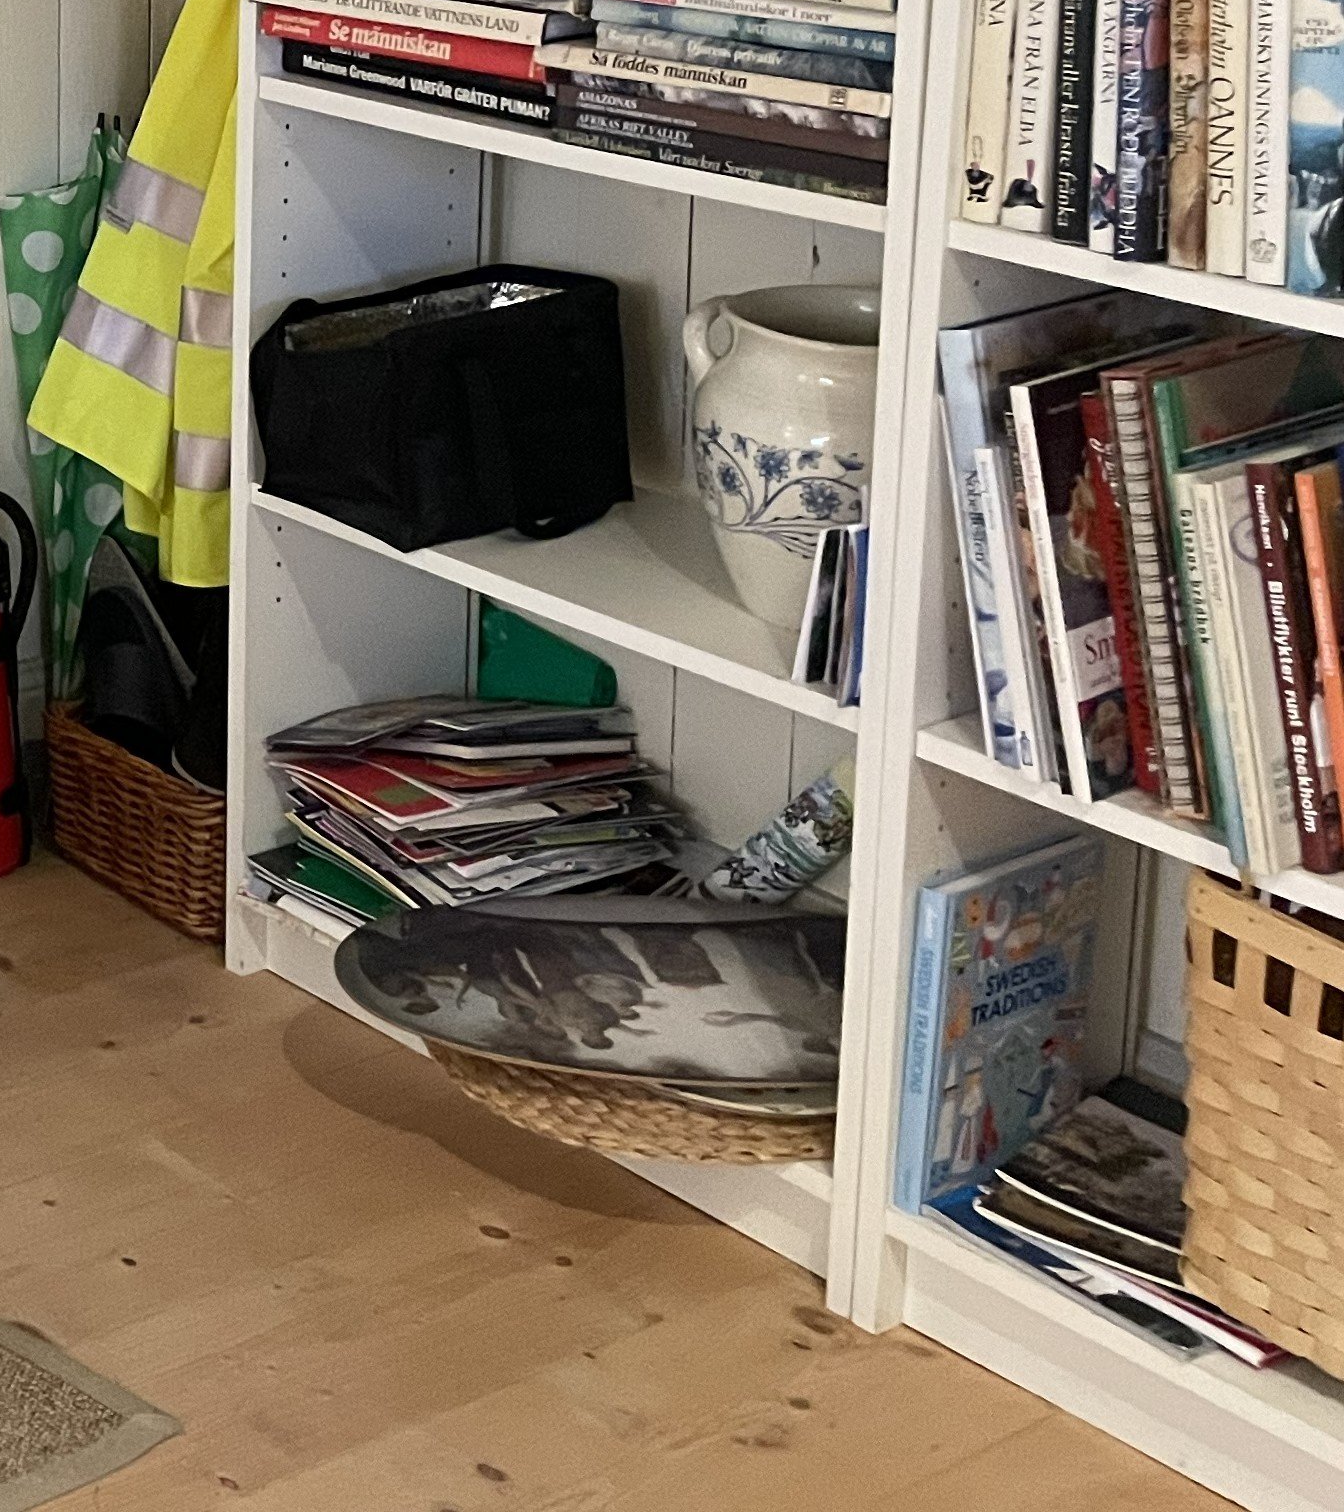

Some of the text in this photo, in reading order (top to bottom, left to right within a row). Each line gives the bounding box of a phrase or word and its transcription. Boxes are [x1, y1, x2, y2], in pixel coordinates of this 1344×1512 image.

[485, 14, 520, 33] LAND
[799, 10, 833, 23] norr
[328, 19, 350, 41] Se
[352, 25, 452, 60] människan
[589, 49, 748, 90] Så föddes människan
[1022, 34, 1044, 90] FRÅN
[1060, 58, 1082, 99] aller
[1122, 59, 1142, 103] DEN
[349, 64, 406, 89] Greenwood
[409, 75, 453, 99] VARFÖR
[454, 86, 498, 110] GRÅTER
[499, 96, 551, 121] PUMAN?
[576, 90, 638, 109] AMAZONAS
[647, 122, 689, 143] VALLEY
[1017, 94, 1039, 147] ELBA
[1058, 101, 1082, 168] käraste
[1205, 75, 1238, 207] OANNES
[1117, 167, 1141, 256] BUDDHA
[1266, 580, 1319, 833] Bilutflykter runt Stockholm
